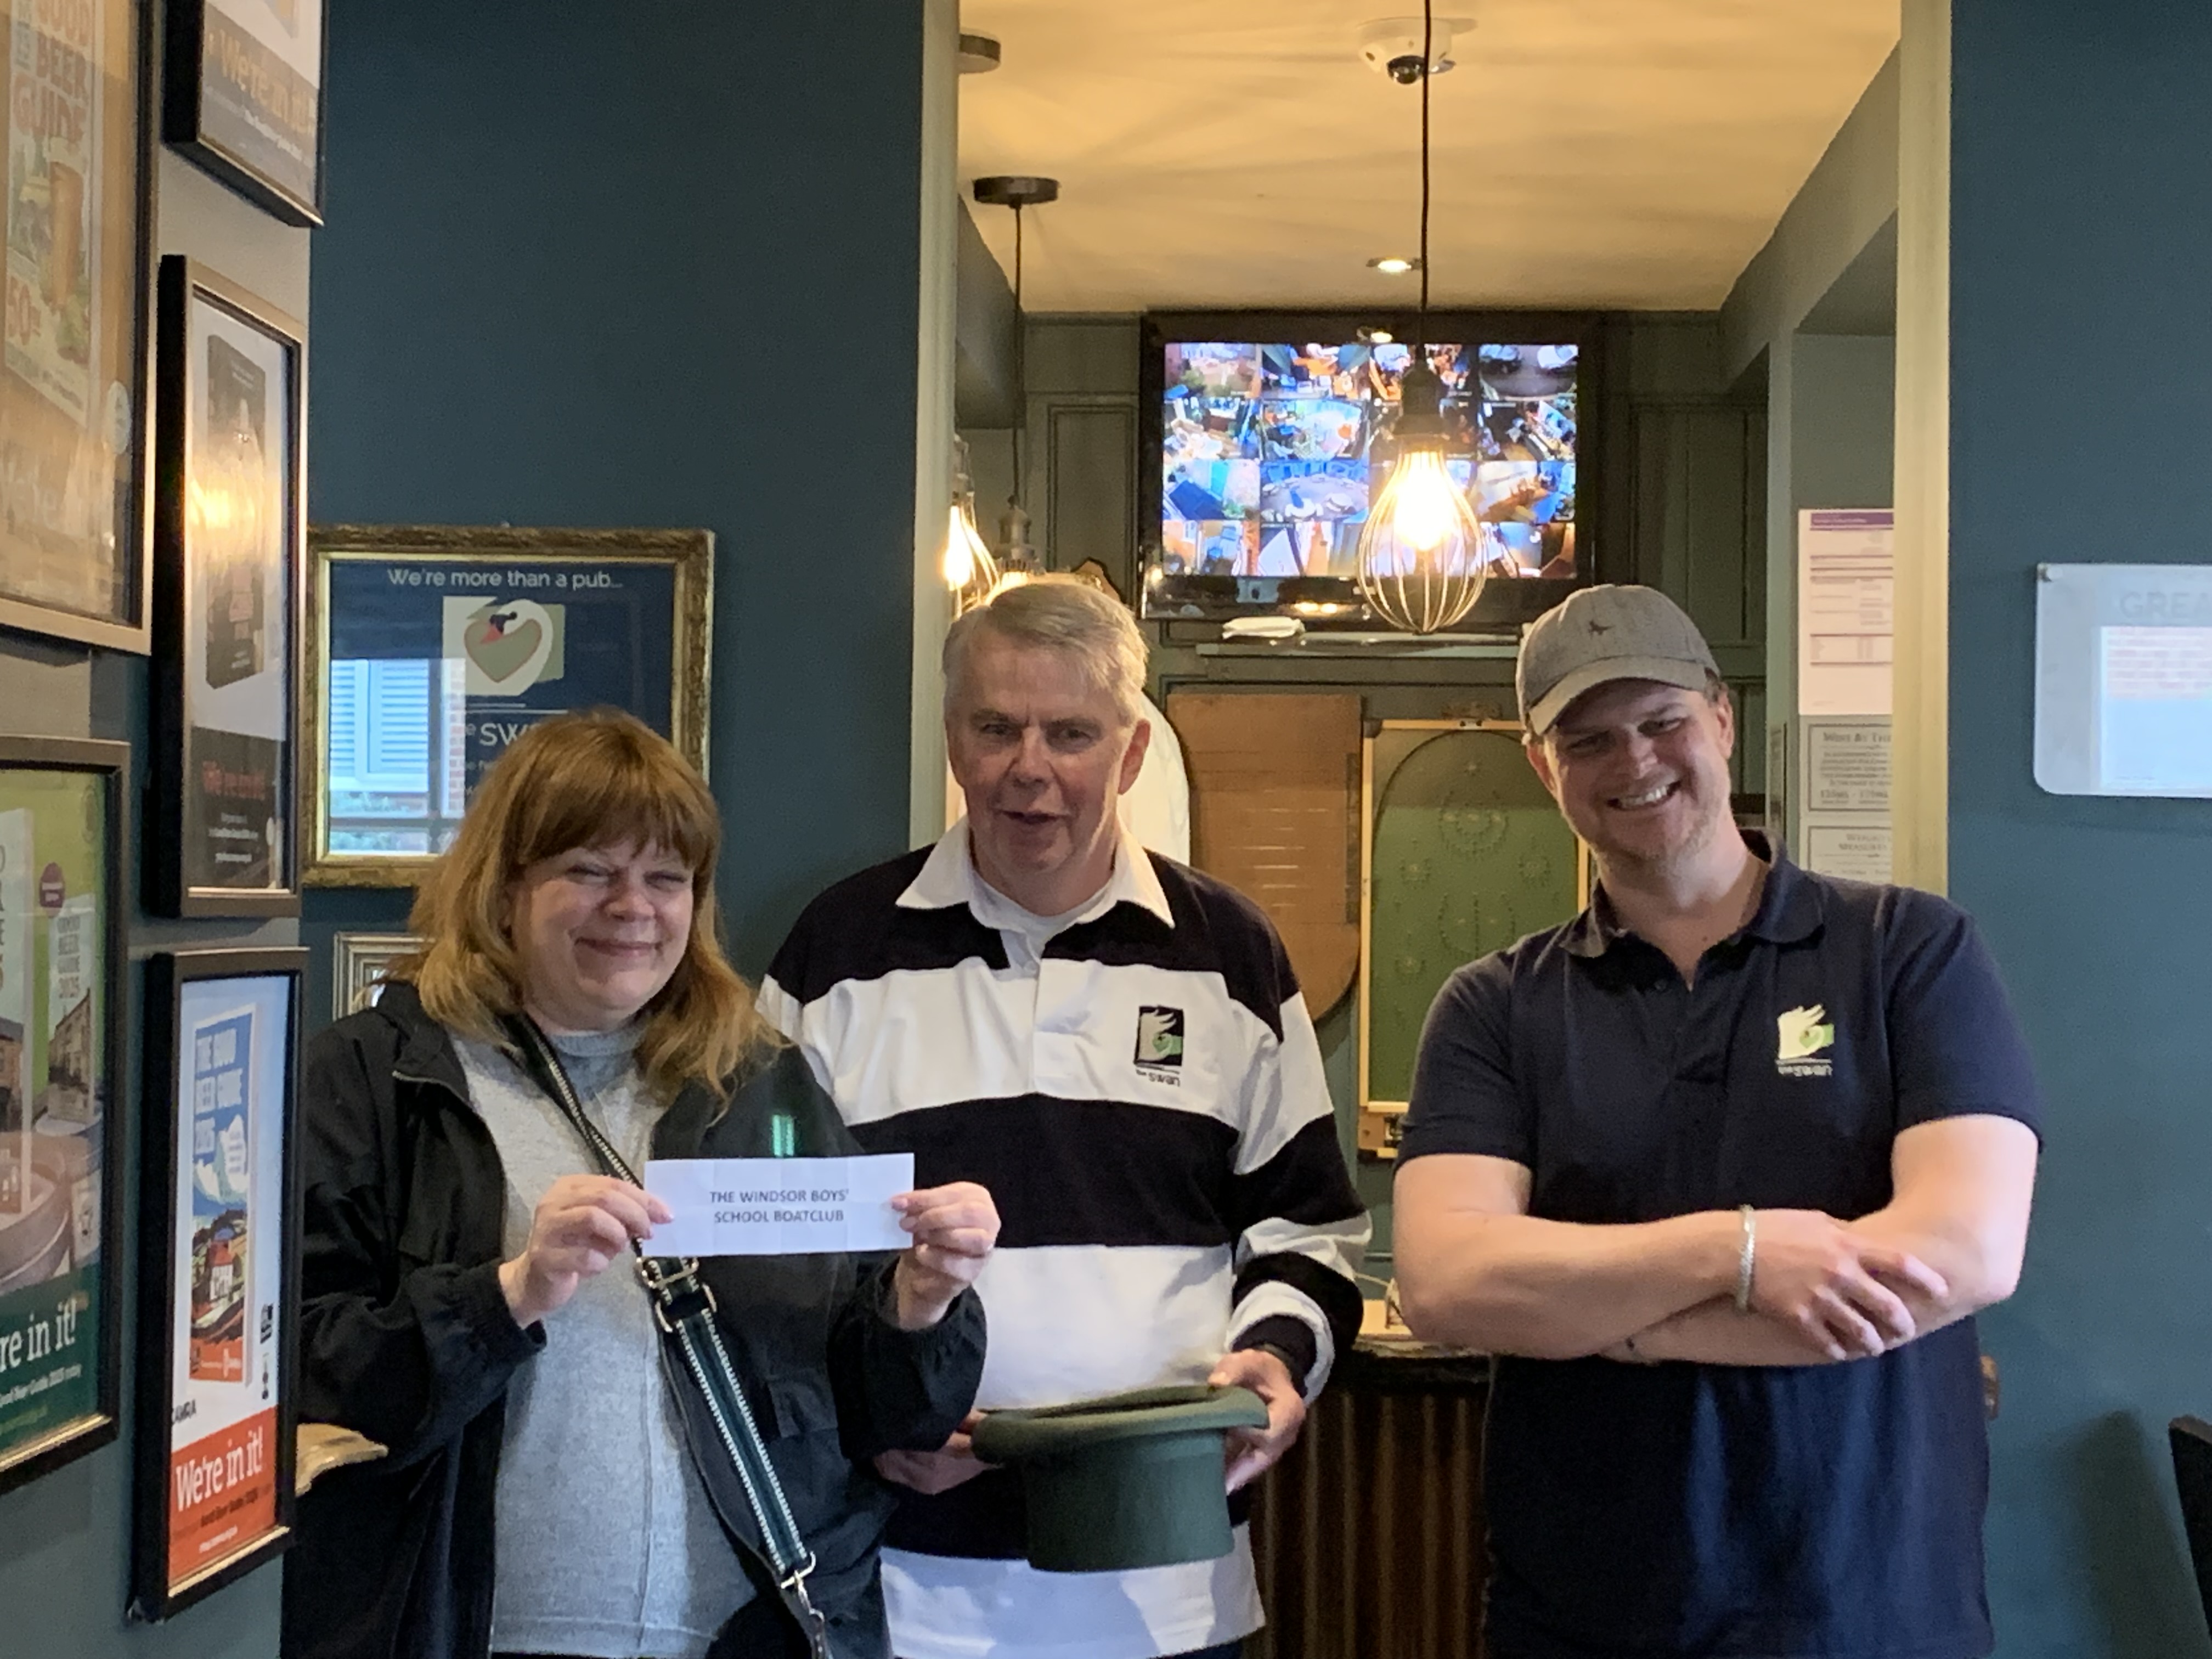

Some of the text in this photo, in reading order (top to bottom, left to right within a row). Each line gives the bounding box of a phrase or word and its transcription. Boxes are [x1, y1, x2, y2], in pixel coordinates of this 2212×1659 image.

[388, 568, 446, 586] We're
[450, 572, 502, 586] more
[507, 570, 550, 587] than
[555, 574, 568, 588] a
[710, 1188, 850, 1203] THE WINDSOR BOYS'
[714, 1210, 844, 1223] SCHOOL BOATCLUB
[27, 1312, 51, 1362] in
[55, 1297, 77, 1352] it!
[176, 1455, 224, 1513] We're
[226, 1438, 245, 1490] in
[246, 1425, 264, 1477] it!
